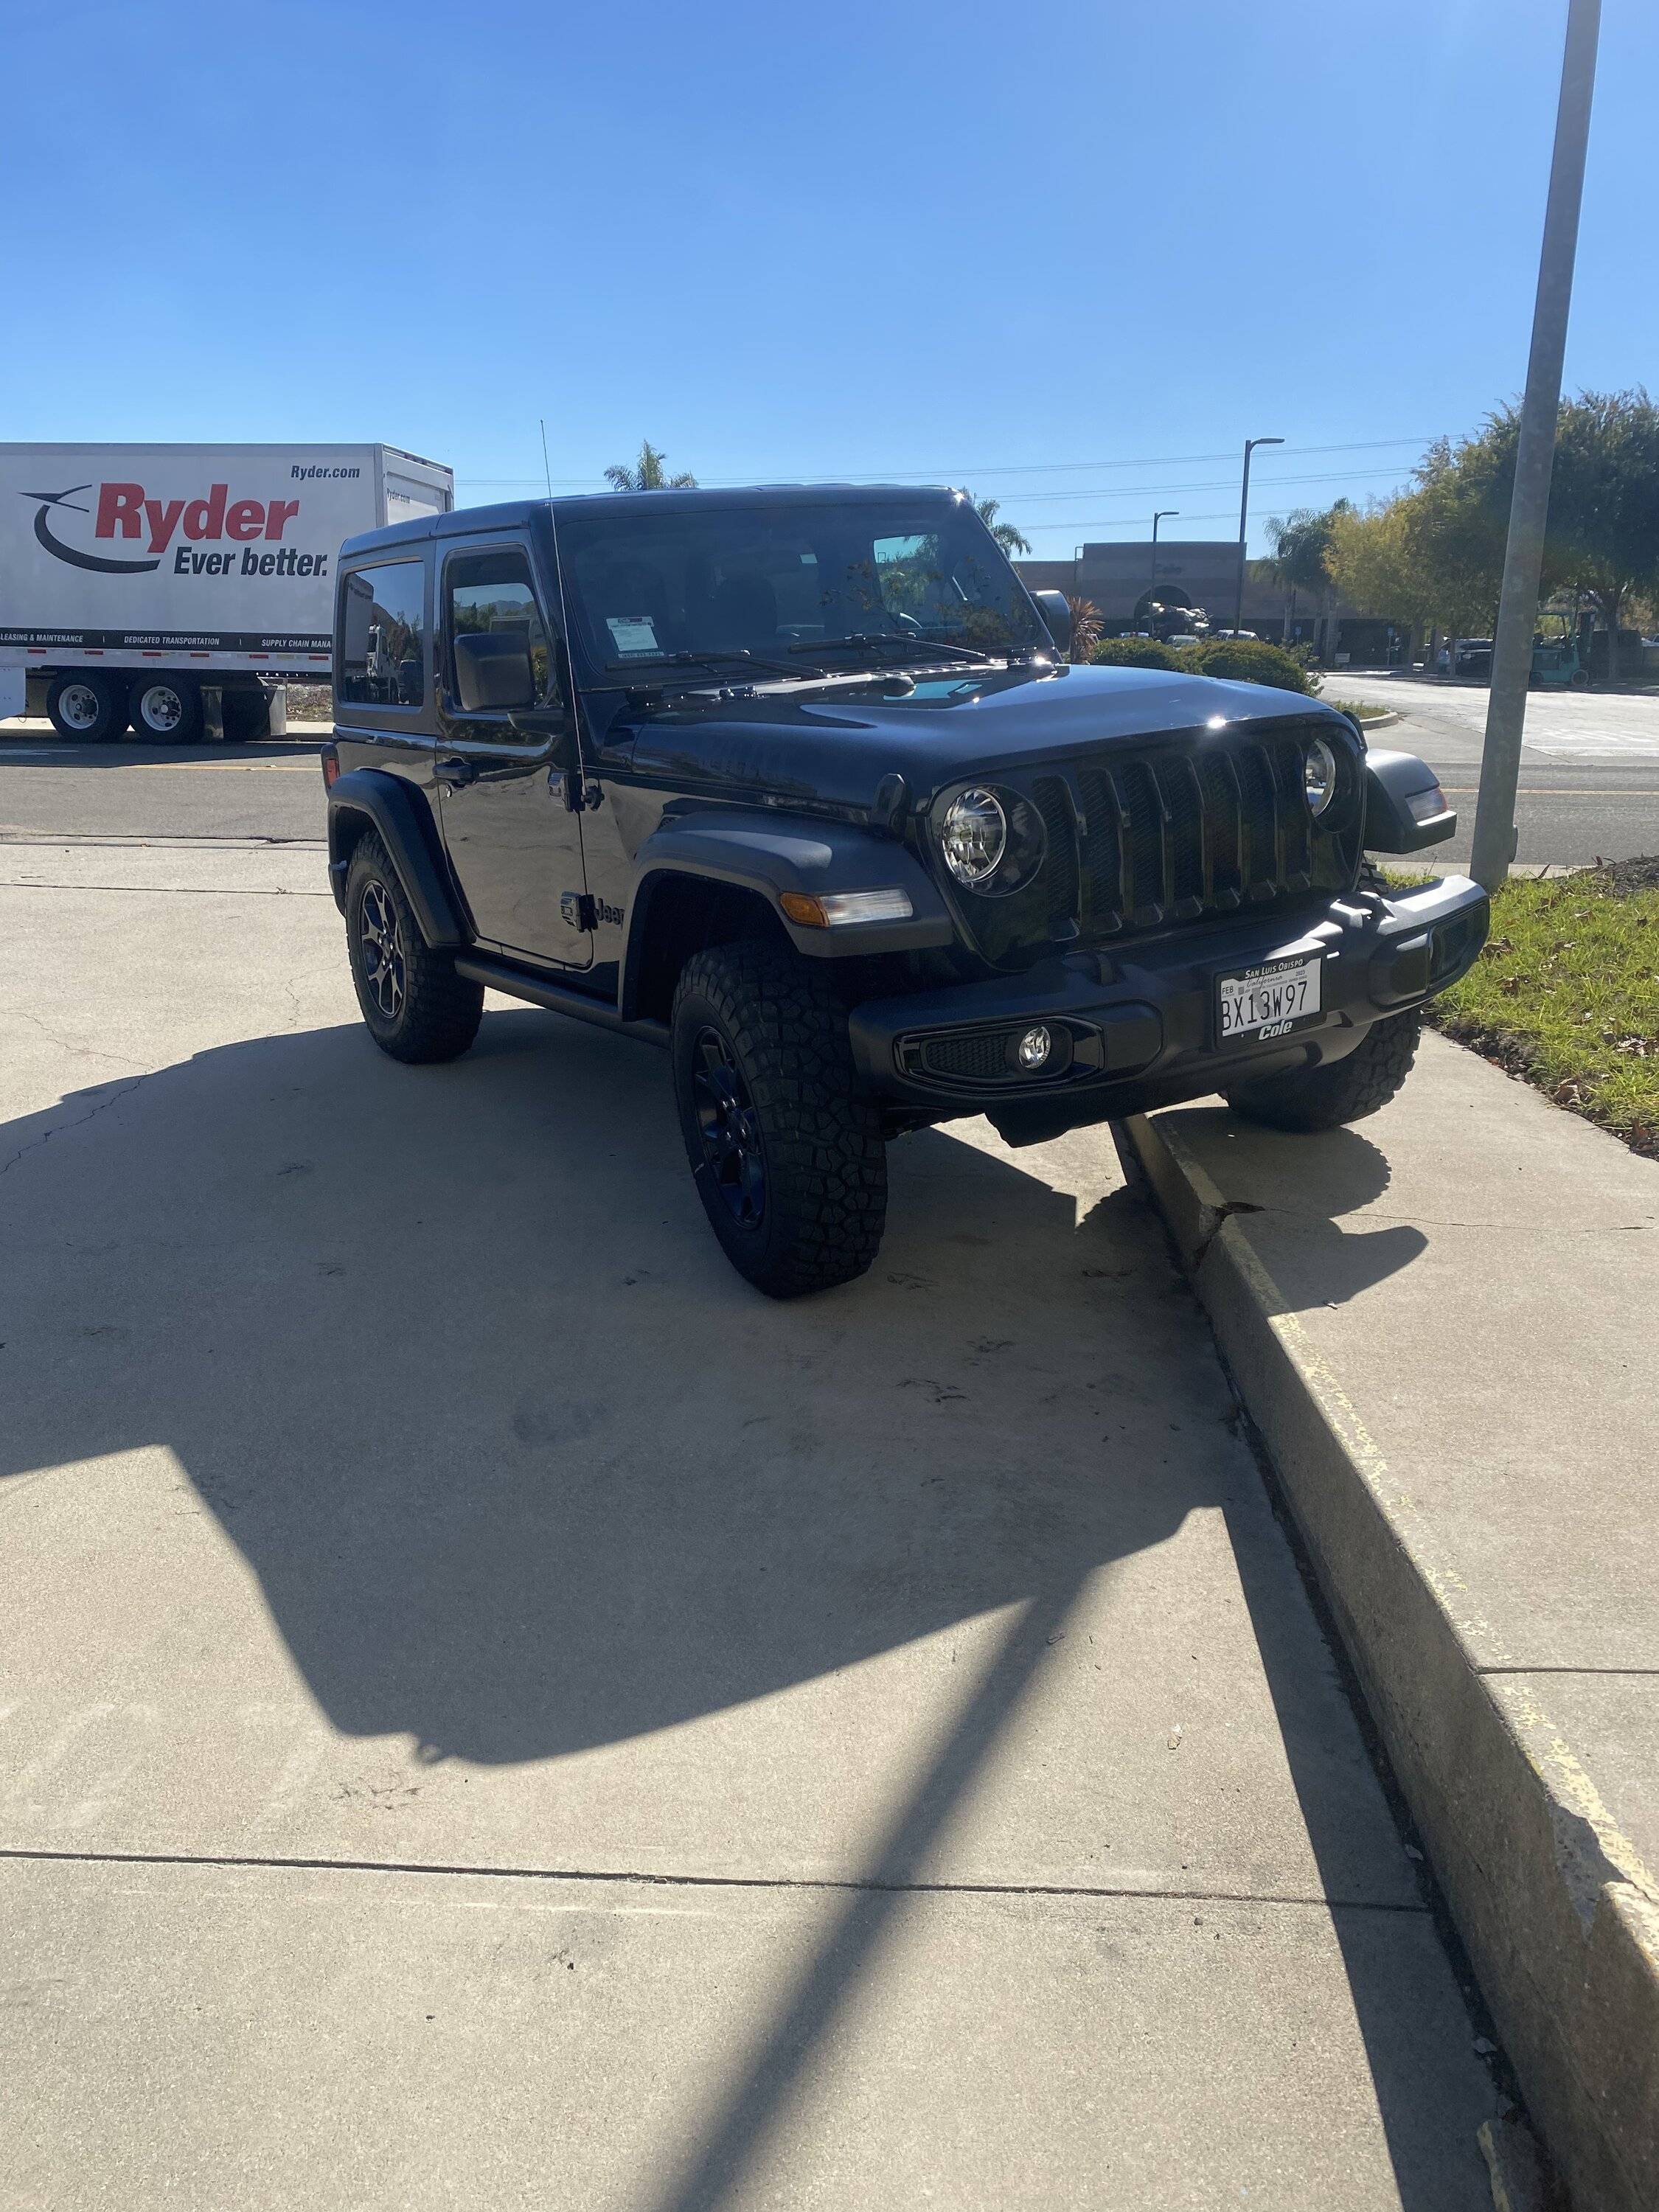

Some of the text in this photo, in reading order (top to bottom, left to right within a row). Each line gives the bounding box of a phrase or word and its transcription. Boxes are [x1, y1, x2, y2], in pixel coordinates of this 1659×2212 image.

[291, 465, 360, 481] Ryder.com
[95, 483, 299, 553] Ryder
[174, 546, 327, 577] Ever better.
[0, 633, 28, 641] LEASING
[36, 634, 83, 643] MAINTENANCE
[124, 636, 220, 645] DEDICATED TRANSPORTATION
[261, 639, 333, 648] SUPPLY CHAIN MANA
[1245, 959, 1304, 979] SAN LUIS OBISPO
[1222, 986, 1234, 995] FEB
[1222, 981, 1307, 1031] BX13W97
[1258, 1020, 1293, 1040] Cole
